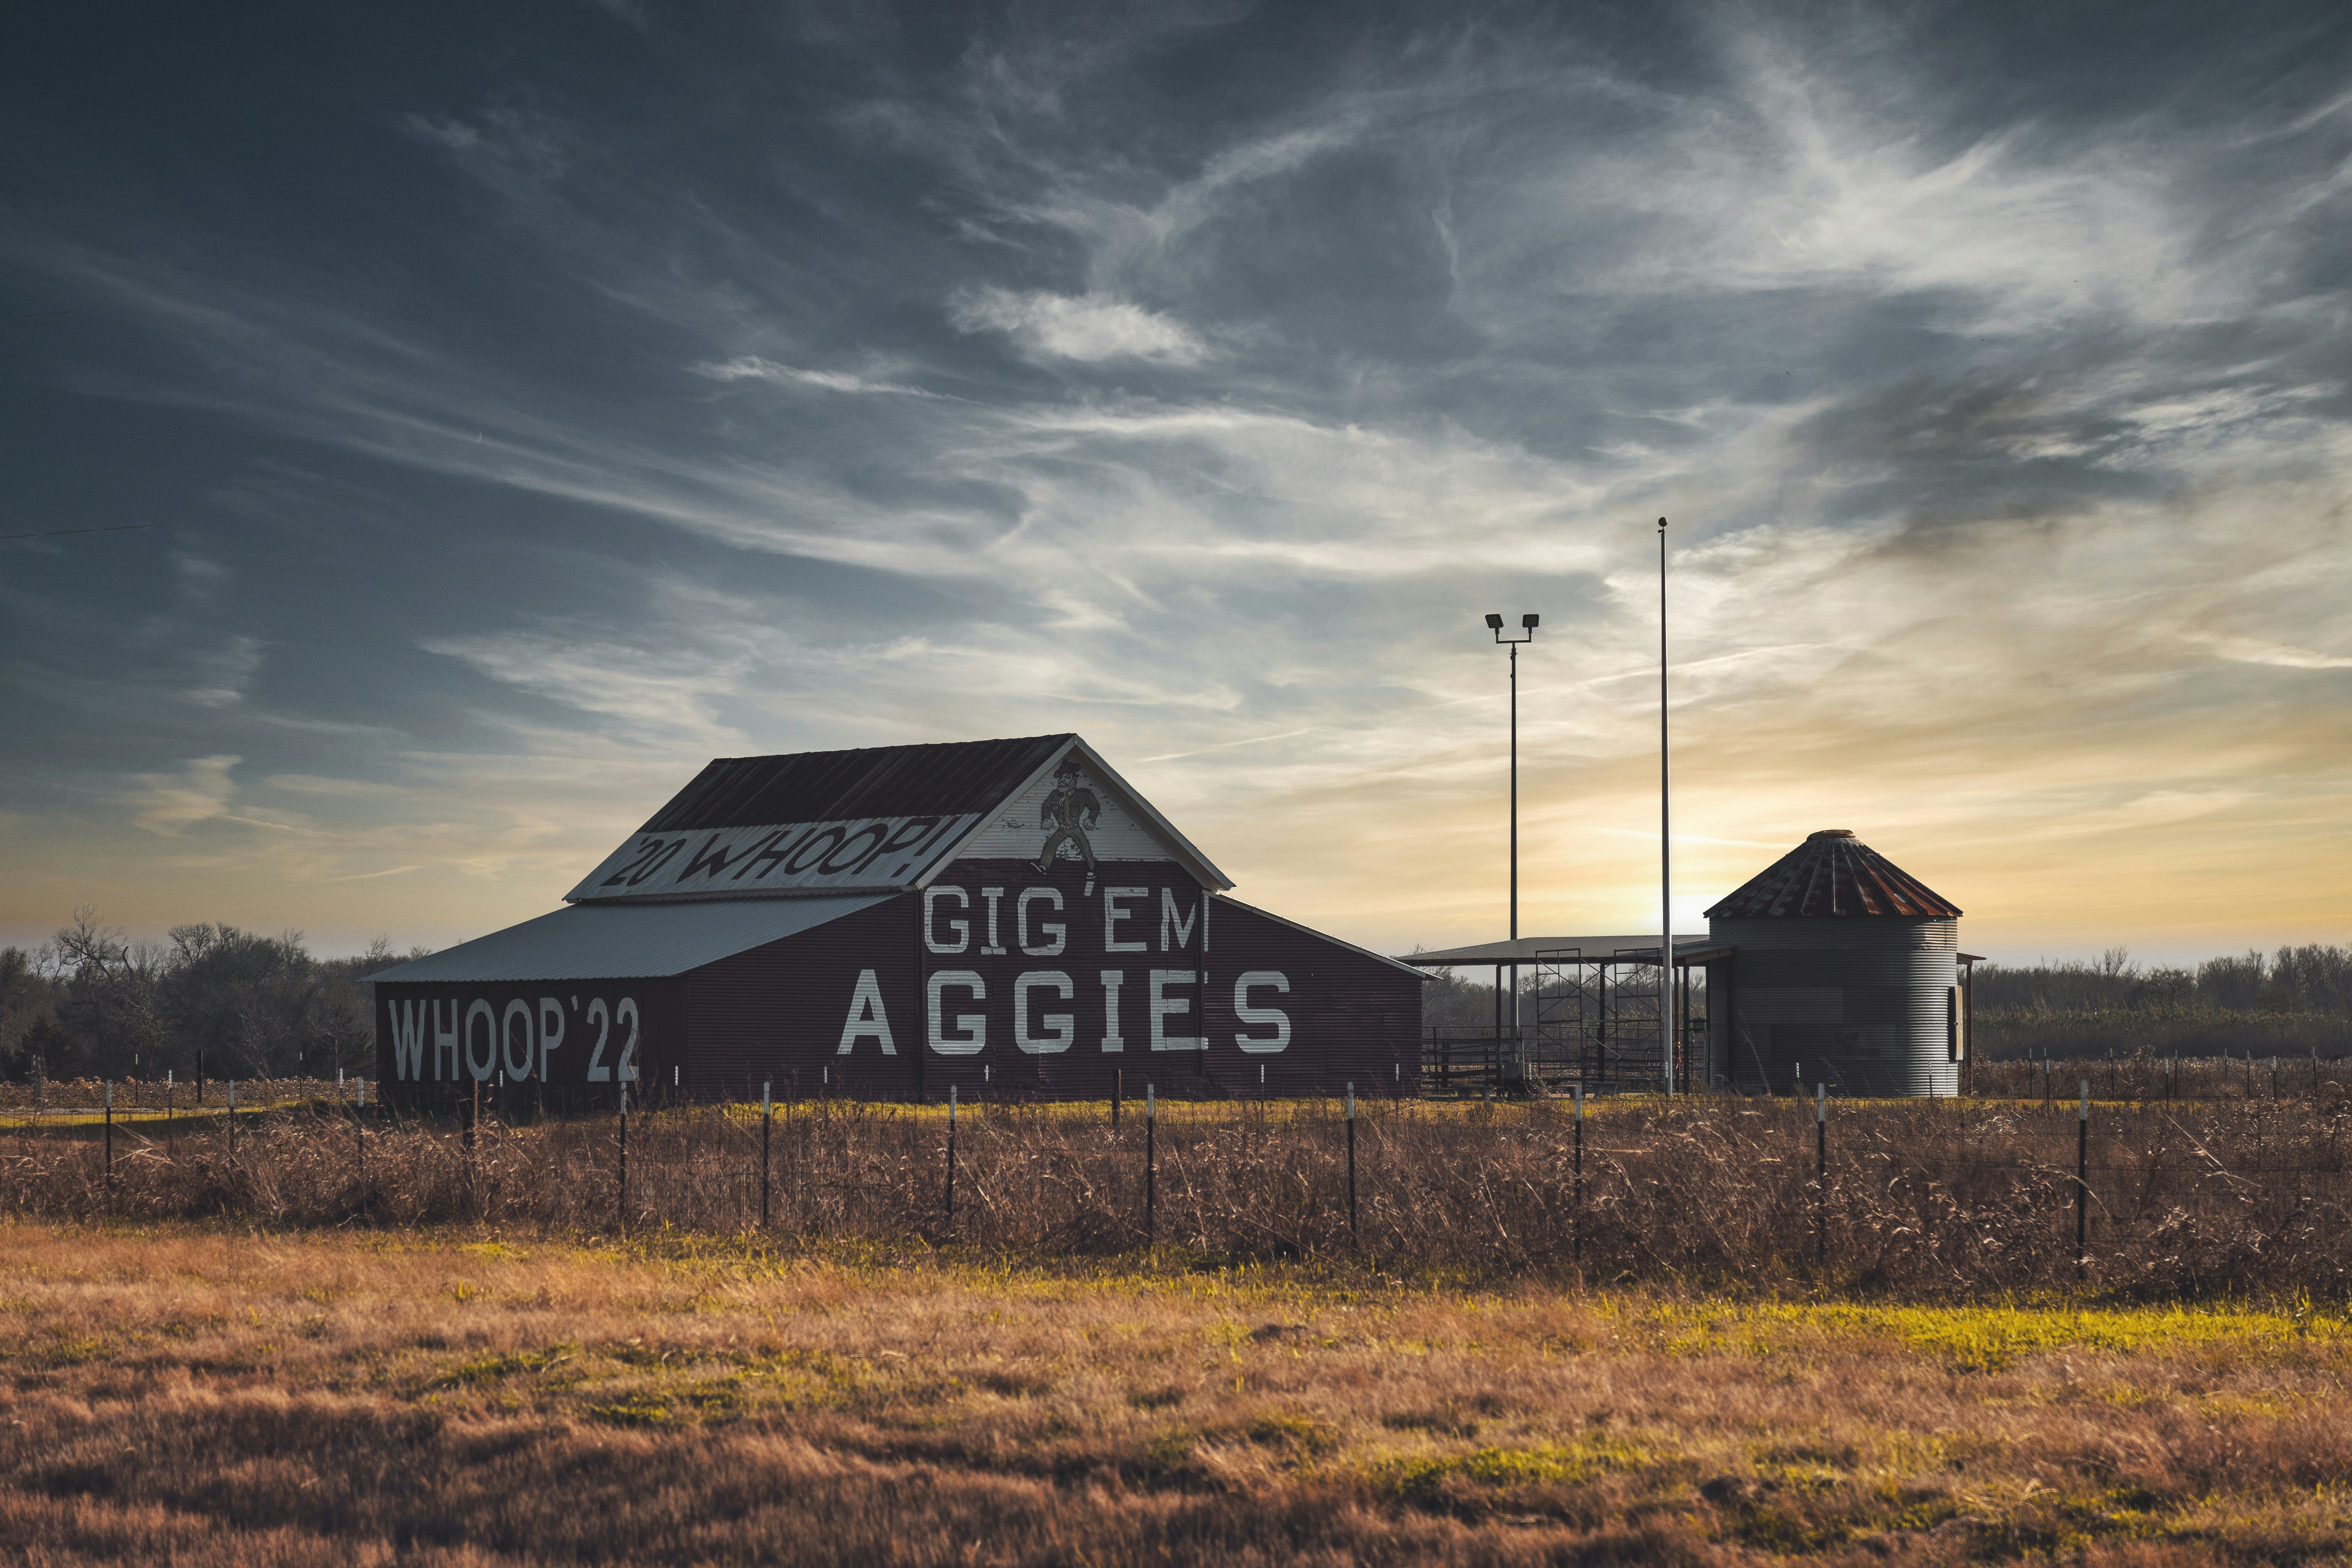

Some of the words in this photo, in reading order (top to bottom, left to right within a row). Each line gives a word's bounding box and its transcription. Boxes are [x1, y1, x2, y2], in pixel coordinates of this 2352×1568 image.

[599, 836, 686, 887] '20
[676, 816, 963, 884] WHOOP!
[924, 885, 1066, 956] GIG
[1084, 881, 1209, 952] 'EM
[836, 970, 1291, 1055] AGGIES
